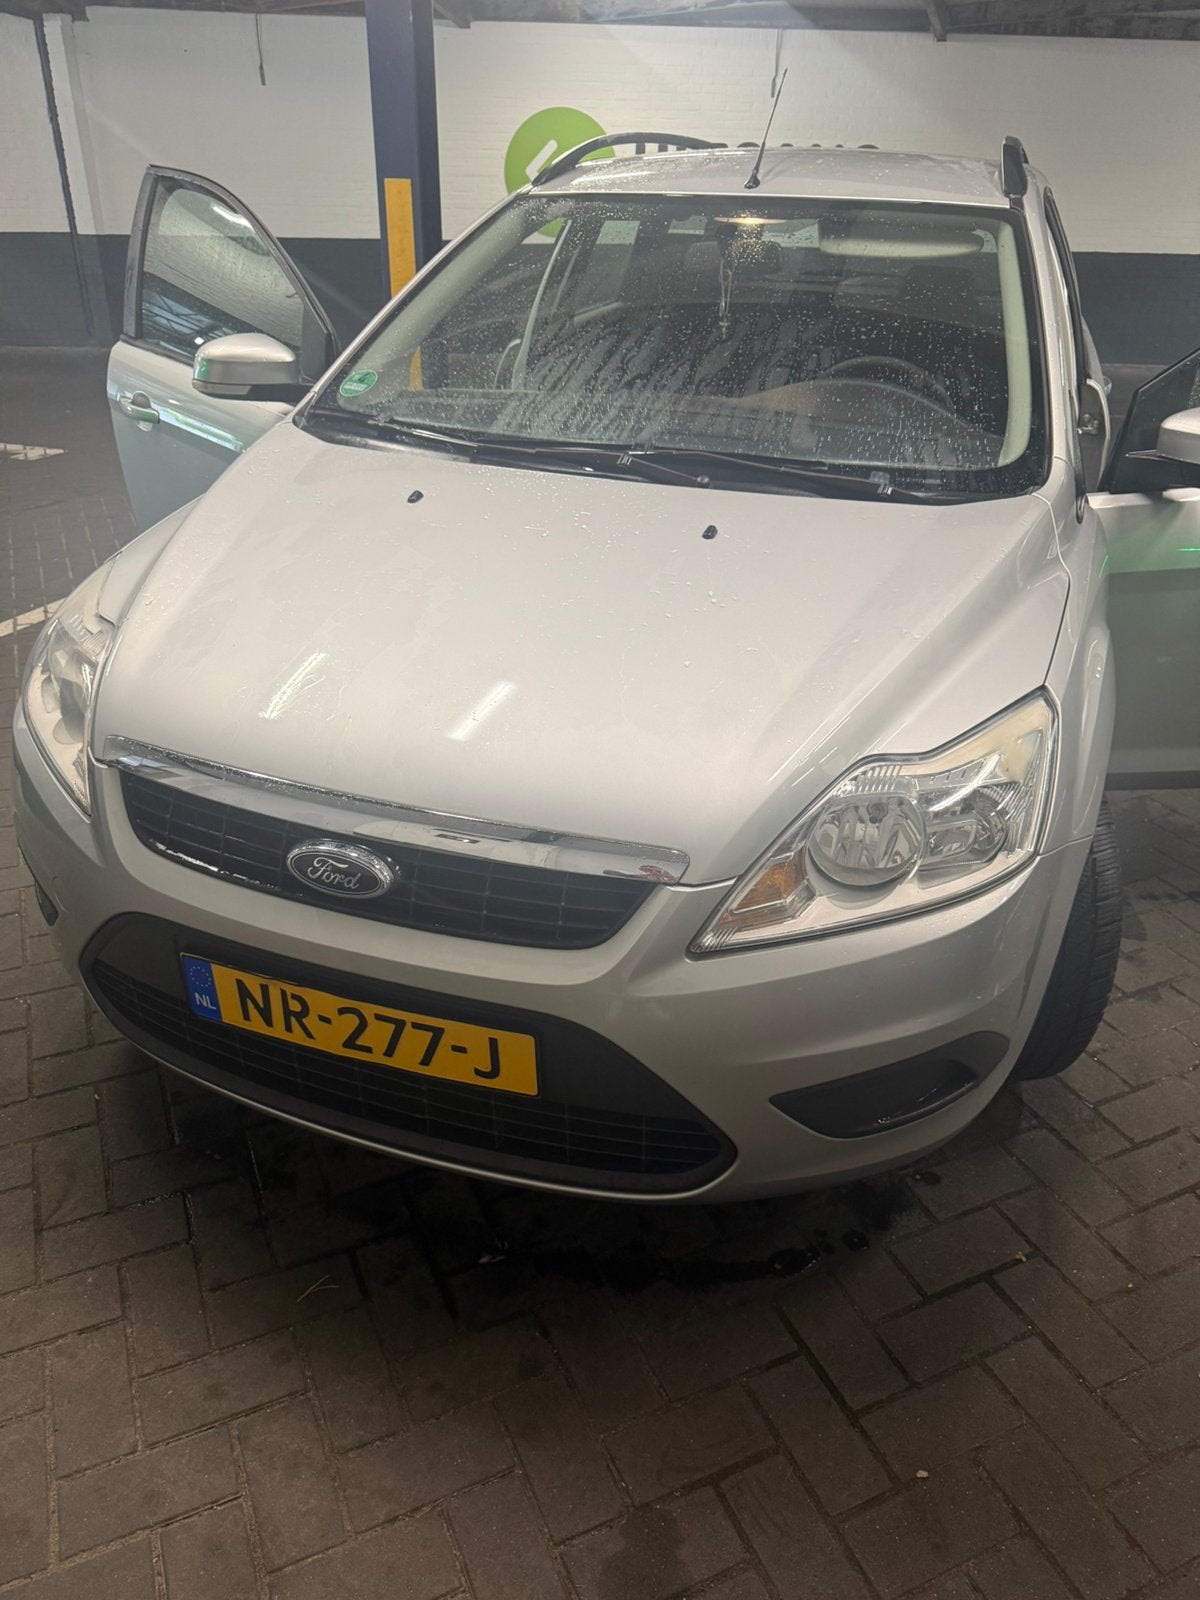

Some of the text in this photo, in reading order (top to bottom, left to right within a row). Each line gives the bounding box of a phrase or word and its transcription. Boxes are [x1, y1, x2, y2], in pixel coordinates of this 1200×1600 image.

[307, 857, 362, 889] Ford
[193, 991, 217, 1011] NL
[235, 978, 501, 1080] NR-277-J
